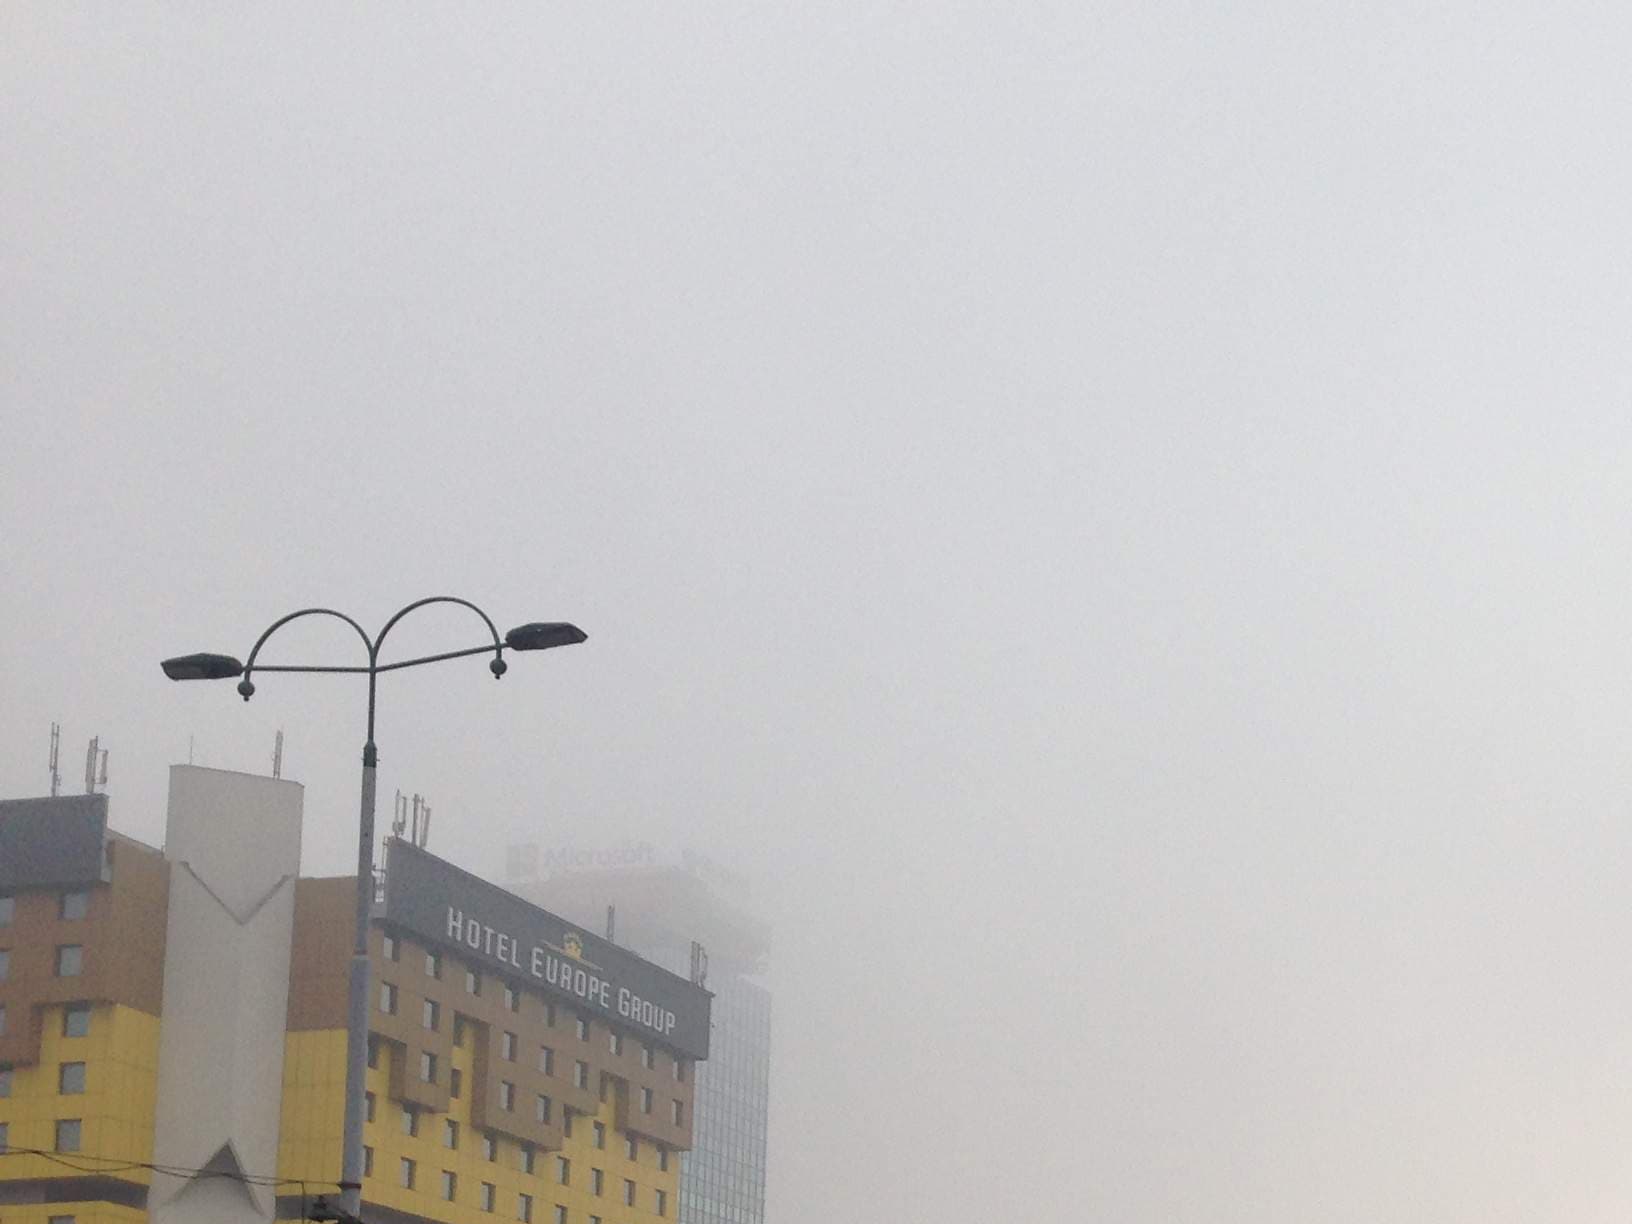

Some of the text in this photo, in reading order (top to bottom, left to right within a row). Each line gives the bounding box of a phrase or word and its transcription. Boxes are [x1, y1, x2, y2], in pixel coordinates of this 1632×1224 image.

[447, 906, 677, 1037] HOTEL EUROPE GROUP
